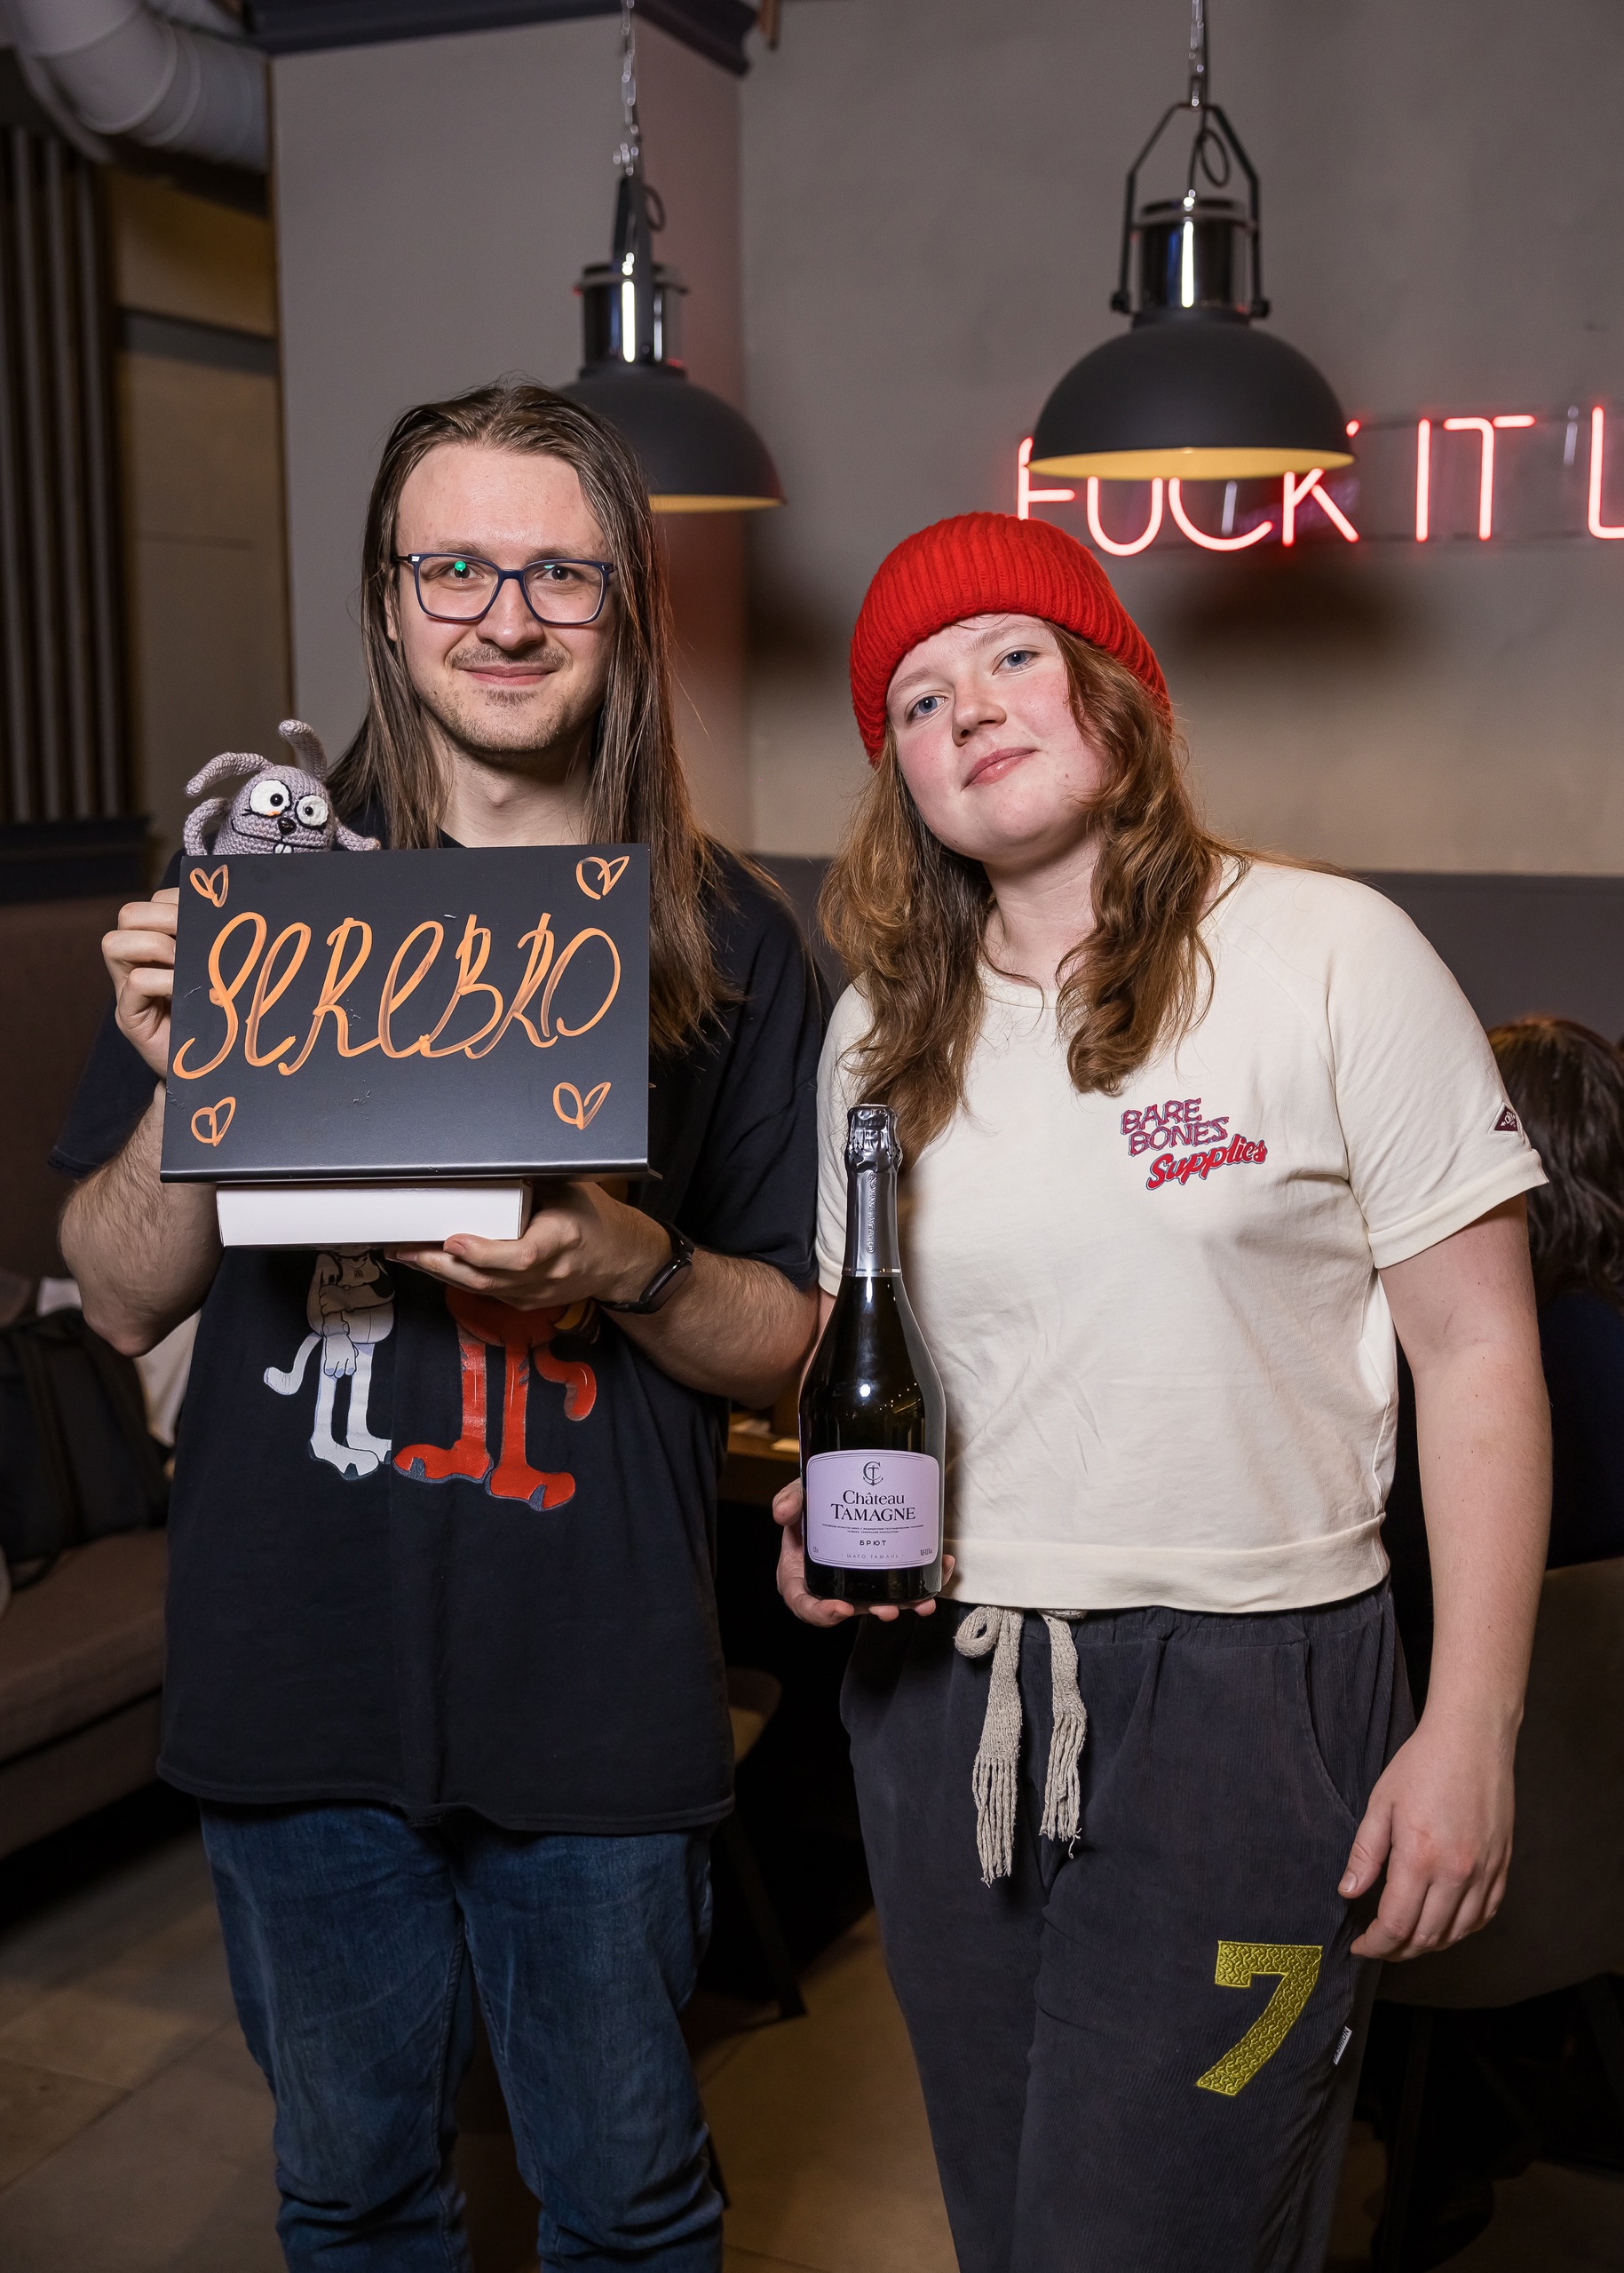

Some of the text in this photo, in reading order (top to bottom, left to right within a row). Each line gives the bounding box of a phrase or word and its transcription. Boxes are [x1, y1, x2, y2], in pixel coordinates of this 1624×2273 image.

[1417, 416, 1535, 543] IT
[1121, 1097, 1202, 1136] BARE
[1129, 1116, 1230, 1157] BONES
[1145, 1133, 1268, 1191] Supplies
[830, 1503, 916, 1522] TAMAGNE
[843, 1490, 905, 1505] Château
[1195, 1940, 1323, 2096] 7
